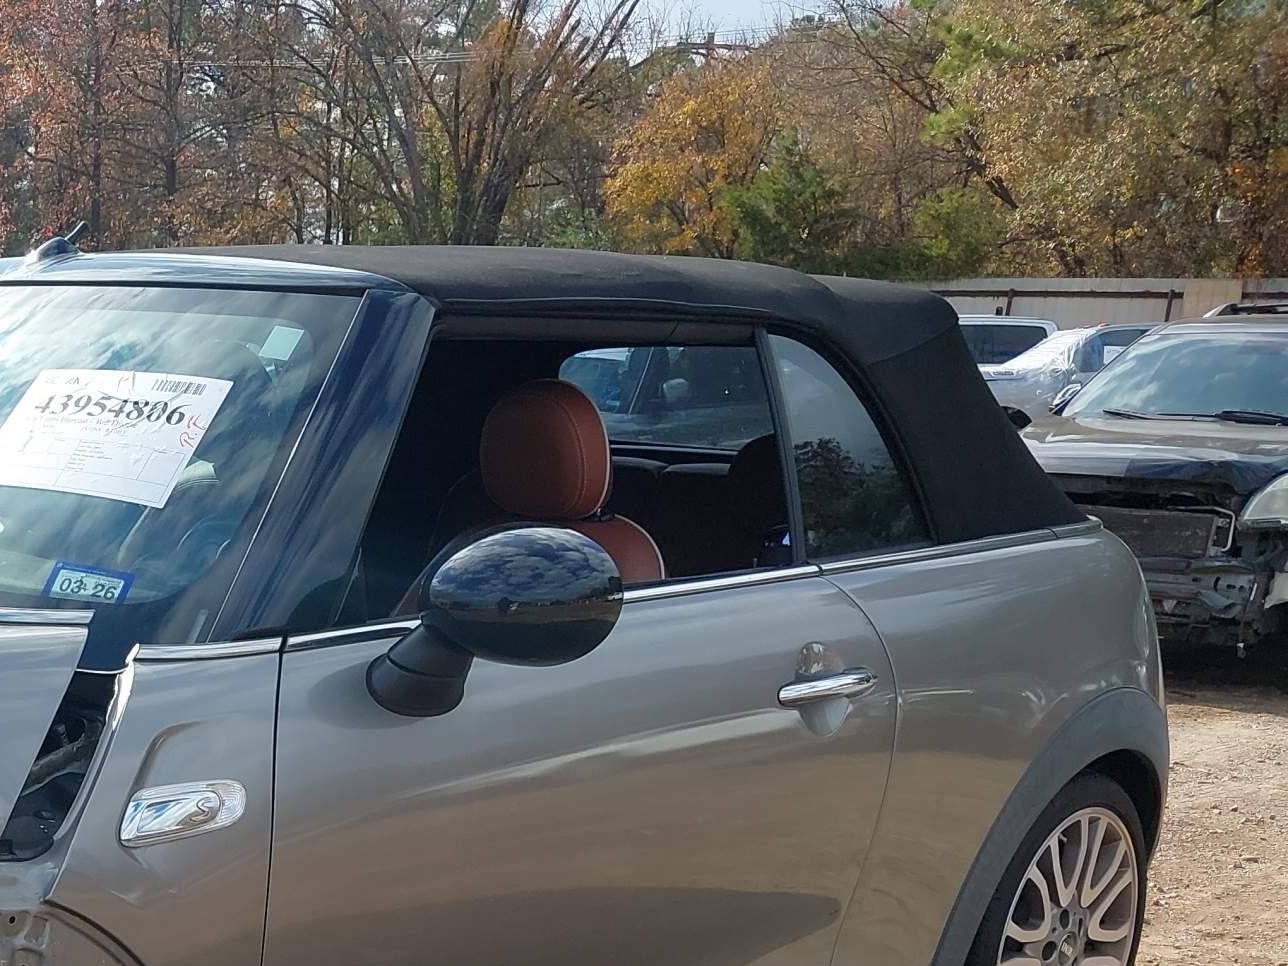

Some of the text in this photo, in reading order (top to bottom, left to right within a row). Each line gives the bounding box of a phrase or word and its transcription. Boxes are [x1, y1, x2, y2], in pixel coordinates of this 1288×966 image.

[34, 394, 192, 425] 43954806
[59, 577, 85, 594] 03
[90, 583, 117, 600] 26
